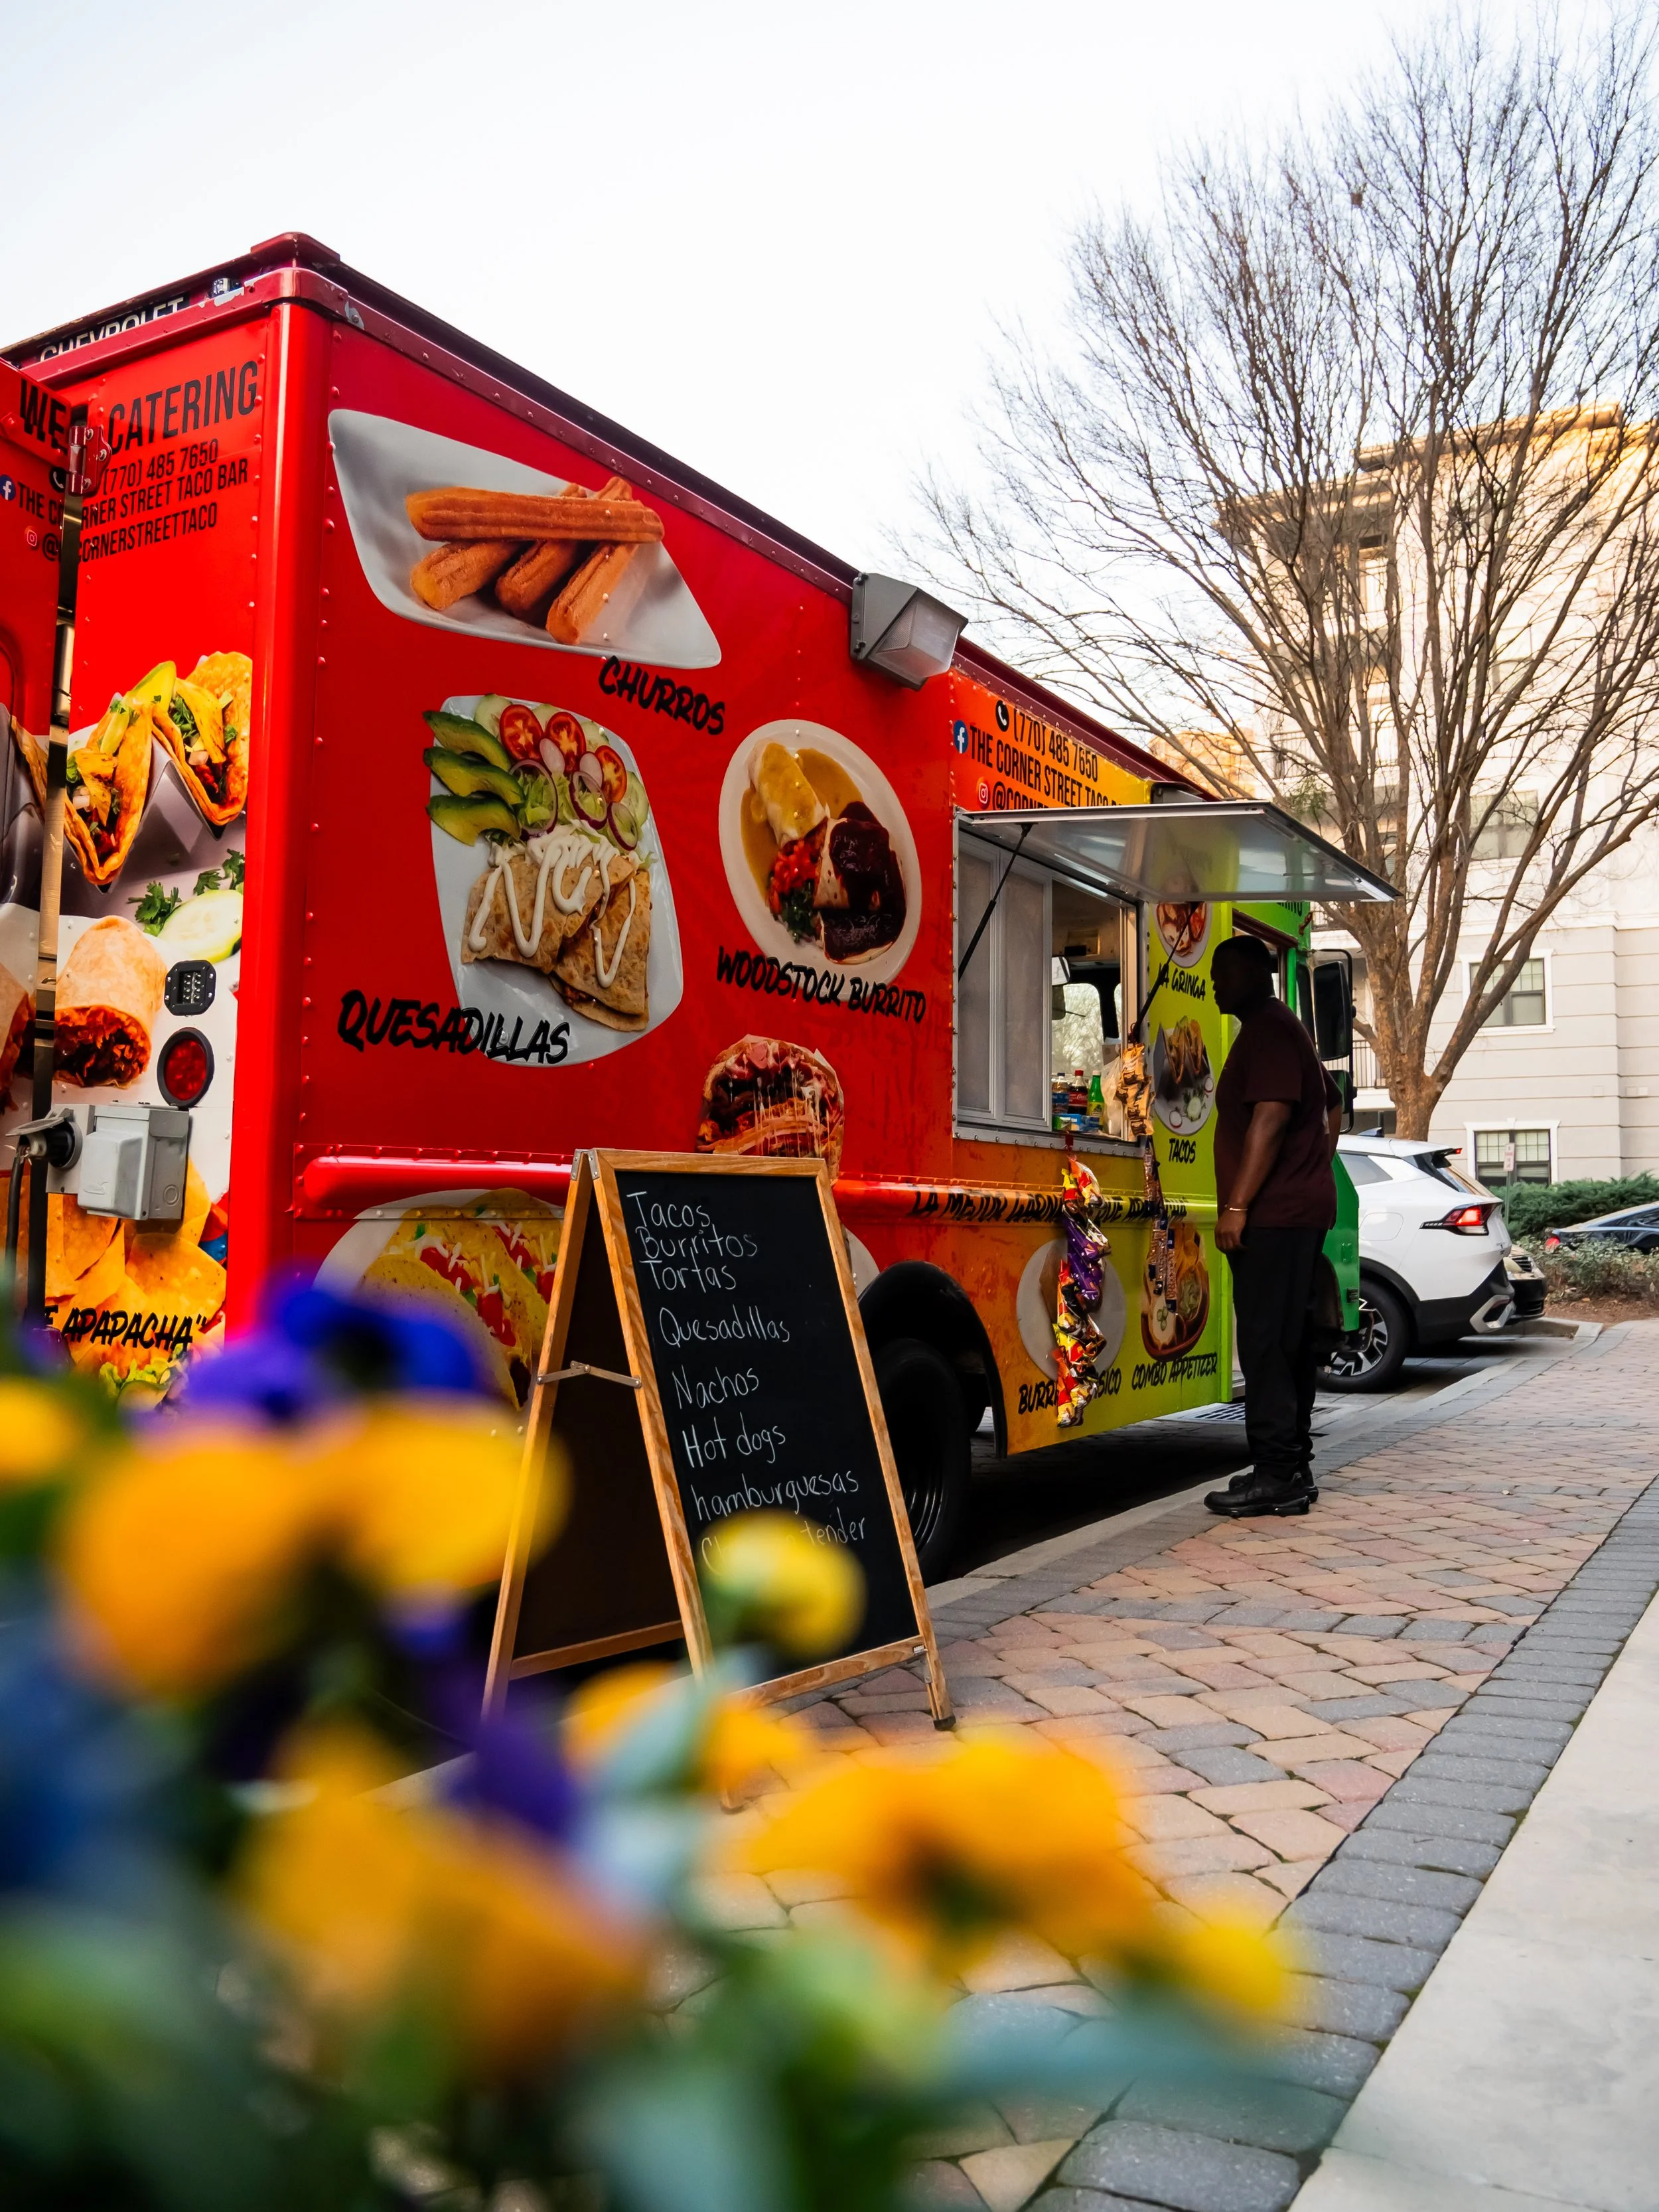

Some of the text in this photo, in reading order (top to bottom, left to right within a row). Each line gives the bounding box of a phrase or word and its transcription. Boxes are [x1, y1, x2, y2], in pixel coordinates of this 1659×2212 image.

[107, 360, 257, 456] CATERING
[18, 482, 44, 519] THE
[120, 473, 172, 519] STREET
[177, 467, 212, 499] TACO
[217, 457, 248, 491] BAR
[103, 438, 218, 496] (770) 485 7650
[599, 656, 726, 735] CHURROS
[969, 726, 993, 768] THE
[997, 739, 1042, 792] CORNER
[1044, 765, 1084, 808] STREET
[1014, 708, 1098, 782] (770) 485 7650
[717, 945, 926, 1023] WOODSTOCK BURRITO
[1171, 967, 1206, 1001] GRINGA
[338, 990, 571, 1065] QUESADILLAS
[1169, 1138, 1196, 1164] TACOS
[626, 1191, 711, 1228] Tacos
[906, 1186, 939, 1217] LA
[635, 1223, 758, 1259] Burritos
[639, 1246, 737, 1293] Tortas
[660, 1303, 790, 1348] Quesadillas
[672, 1364, 759, 1410] Nachos
[1131, 1351, 1218, 1391] COMBO APPETIZER
[1018, 1379, 1058, 1415] BURR
[682, 1412, 786, 1468] Hot dogs
[691, 1471, 859, 1521] hamburguesas
[800, 1507, 865, 1545] tender
